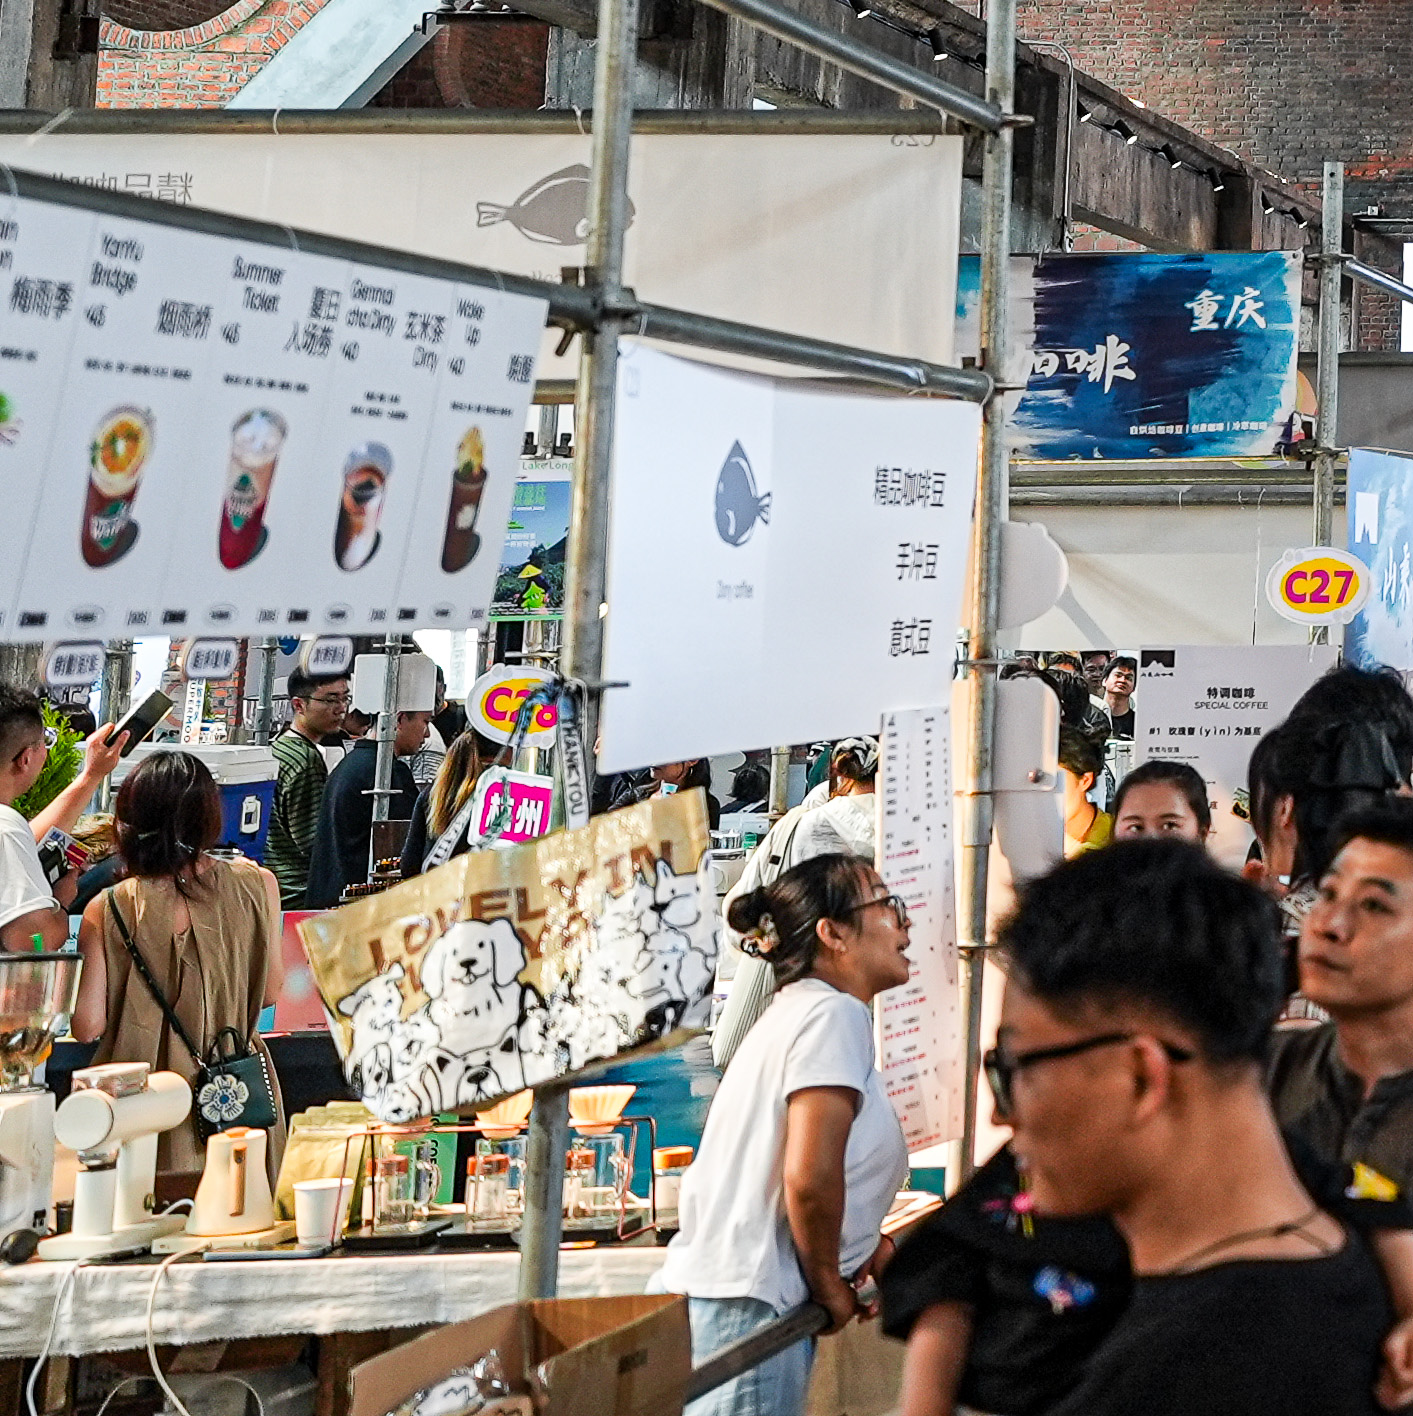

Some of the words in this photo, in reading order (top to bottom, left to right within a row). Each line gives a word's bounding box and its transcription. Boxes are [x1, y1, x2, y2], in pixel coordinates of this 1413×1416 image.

[1184, 287, 1268, 333] 重庆
[874, 464, 947, 509] 精品咖啡豆
[895, 541, 940, 582] 手冲豆
[1285, 568, 1355, 604] C27
[1194, 701, 1231, 710] SPECIAL
[1232, 701, 1269, 710] COFFEE
[1206, 687, 1256, 699] 特调咖啡
[1149, 727, 1161, 736] #1
